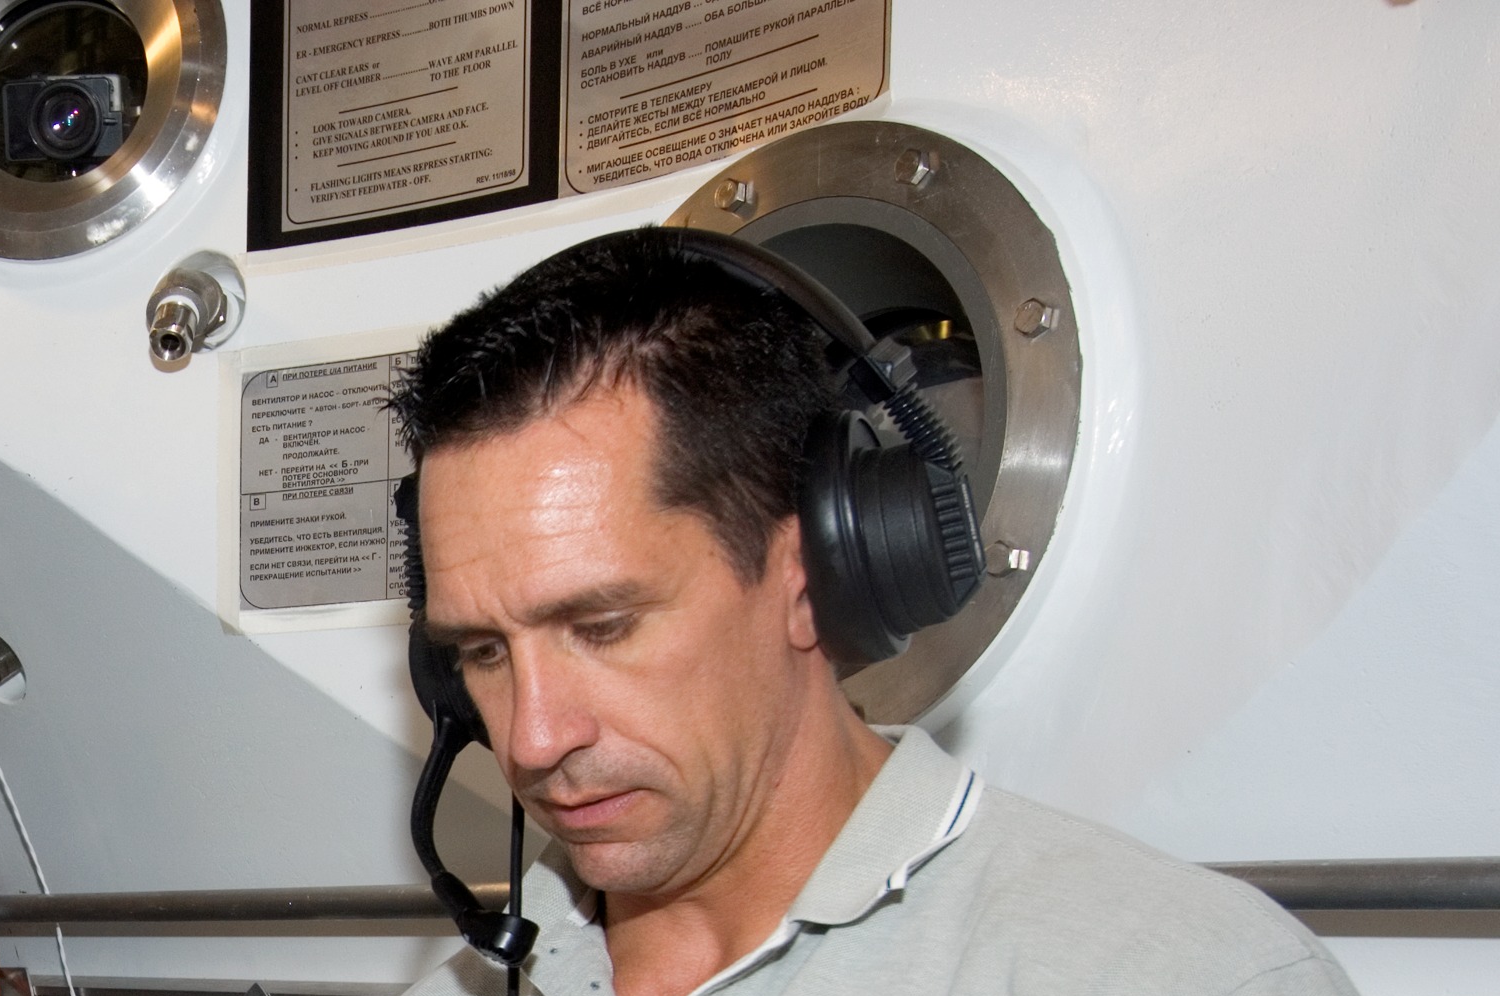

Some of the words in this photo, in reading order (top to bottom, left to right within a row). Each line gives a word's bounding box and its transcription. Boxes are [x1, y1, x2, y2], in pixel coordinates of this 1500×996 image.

[296, 19, 331, 33] NORMAL
[333, 12, 368, 26] REPRESS
[296, 50, 306, 59] ER
[313, 38, 364, 56] EMERGENCY
[366, 30, 400, 44] REPRESS
[429, 18, 451, 28] BOTH
[454, 8, 486, 23] THUMBS
[489, 1, 513, 14] DOWN
[581, 33, 641, 60] АВАРИЙНЫЙ
[644, 22, 682, 42] НАДДУВ
[704, 7, 724, 22] ОБА
[582, 13, 649, 41] НОРМАЛЬНЫЙ
[652, 1, 690, 21] НАДДУВ
[295, 73, 316, 84] CANT
[320, 67, 346, 79] CLEAR
[348, 62, 368, 74] EARS
[296, 85, 320, 97] LEVEL
[323, 81, 338, 91] OFF
[341, 73, 380, 88] CHAMBER
[428, 56, 452, 68] WAVE
[455, 51, 472, 63] ARM
[475, 40, 517, 57] PARALLEL
[430, 72, 440, 81] TO
[443, 67, 458, 78] THE
[463, 60, 490, 73] FLOOR
[580, 62, 644, 89] ОСТАНОВИТЬ
[647, 51, 685, 71] НАДДУВ
[705, 27, 760, 52] ПОМАШИТЕ
[763, 14, 794, 33] РУКОЙ
[580, 63, 606, 78] БОЛЬ
[609, 60, 616, 70] В
[619, 54, 636, 67] УХЕ
[646, 48, 663, 59] или
[706, 49, 731, 65] ПОЛУ
[313, 122, 335, 133] LOOK
[338, 114, 372, 128] TOWARD
[375, 107, 410, 121] CAMERA.
[587, 116, 630, 139] ДЕЛАЙТЕ
[633, 107, 668, 125] ЖЕСТЫ
[671, 95, 705, 115] МЕЖДУ
[708, 71, 778, 103] ТЕЛЕКАМЕРОЙ
[781, 70, 787, 80] И
[789, 57, 826, 77] ЛИЦОМ.
[587, 102, 638, 125] СМОТРИТЕ
[641, 99, 647, 110] В
[650, 80, 712, 107] ТЕЛЕКАМЕРУ
[313, 134, 332, 146] GIVE
[334, 128, 367, 142] SIGNALS
[371, 120, 408, 134] BETWEEN
[410, 112, 443, 126] CAMERA
[447, 107, 463, 118] AND
[466, 102, 488, 113] FACE.
[313, 147, 333, 158] KEEP
[336, 140, 368, 154] MOVING
[371, 134, 403, 147] AROUND
[406, 131, 413, 141] IF
[416, 127, 430, 138] YOU
[434, 123, 450, 134] ARE
[452, 119, 468, 130] O.K.
[586, 123, 651, 151] ДВИГАЙТЕСЬ,
[654, 117, 679, 131] ЕСЛИ
[704, 90, 765, 117] НОРМАЛЬНО
[586, 150, 642, 177] МИГАЮЩЕЕ
[645, 134, 705, 160] ОСВЕЩЕНИЕ
[709, 131, 715, 141] О
[718, 117, 761, 138] ЗНАЧАЕТ
[765, 103, 804, 123] НАЧАЛО
[807, 86, 853, 110] НАДДУВА
[593, 160, 650, 186] УБЕДИТЕСЬ,
[654, 155, 675, 169] ЧТО
[678, 147, 702, 163] ВОДА
[705, 129, 764, 155] ОТКЛЮЧЕНА
[767, 122, 787, 136] ИЛИ
[789, 104, 840, 128] ЗАКРОЙТЕ
[310, 176, 350, 192] FLASHING
[353, 170, 381, 184] LIGHTS
[384, 165, 410, 178] MEANS
[413, 157, 447, 171] REPRESS
[450, 147, 492, 163] STARTING:
[310, 187, 356, 204] VERIFY/SET
[358, 177, 407, 196] FEEDWATER
[413, 173, 431, 185] OFF.
[476, 174, 490, 183] REV.
